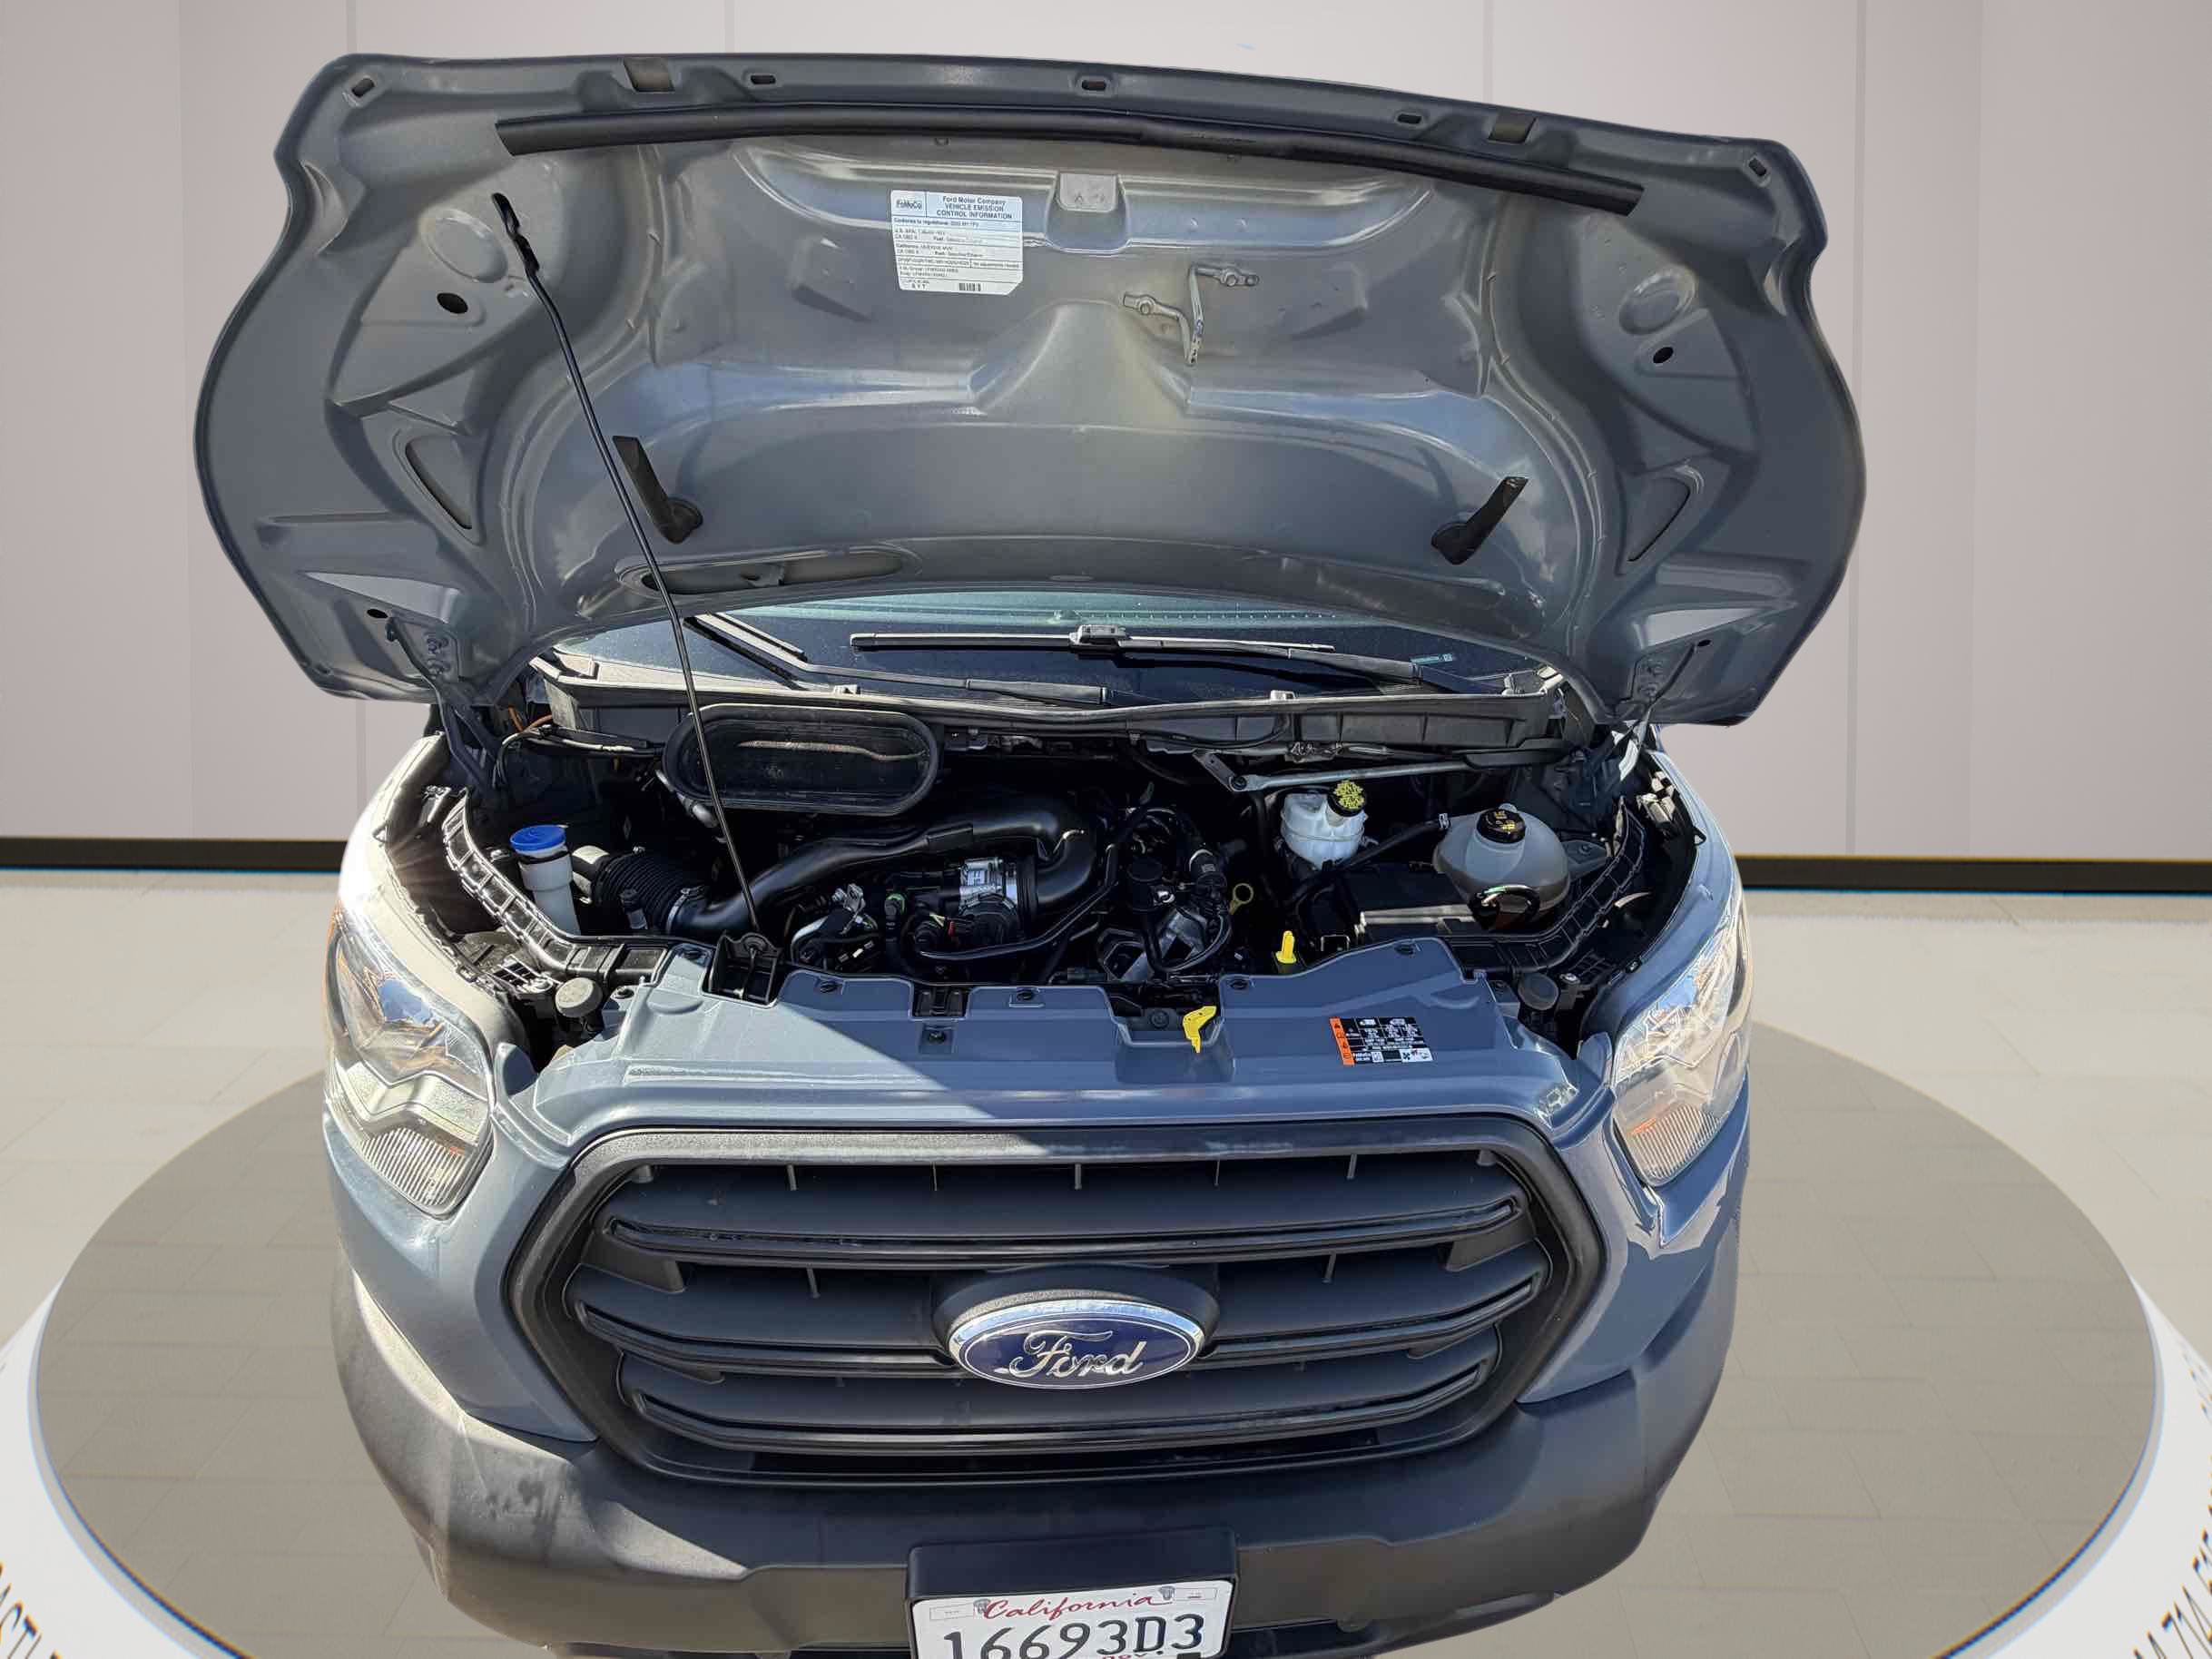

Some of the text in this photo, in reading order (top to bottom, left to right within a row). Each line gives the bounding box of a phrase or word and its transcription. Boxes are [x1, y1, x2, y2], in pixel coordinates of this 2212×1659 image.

[945, 202, 1005, 212] VEHICLE EMISSION
[959, 196, 976, 204] Motor
[977, 197, 1007, 206] Company
[936, 210, 1013, 220] CONTROL INFORMATION
[994, 1330, 1148, 1378] Ford
[983, 1593, 1173, 1622] California
[944, 1613, 1205, 1659] 16693D3
